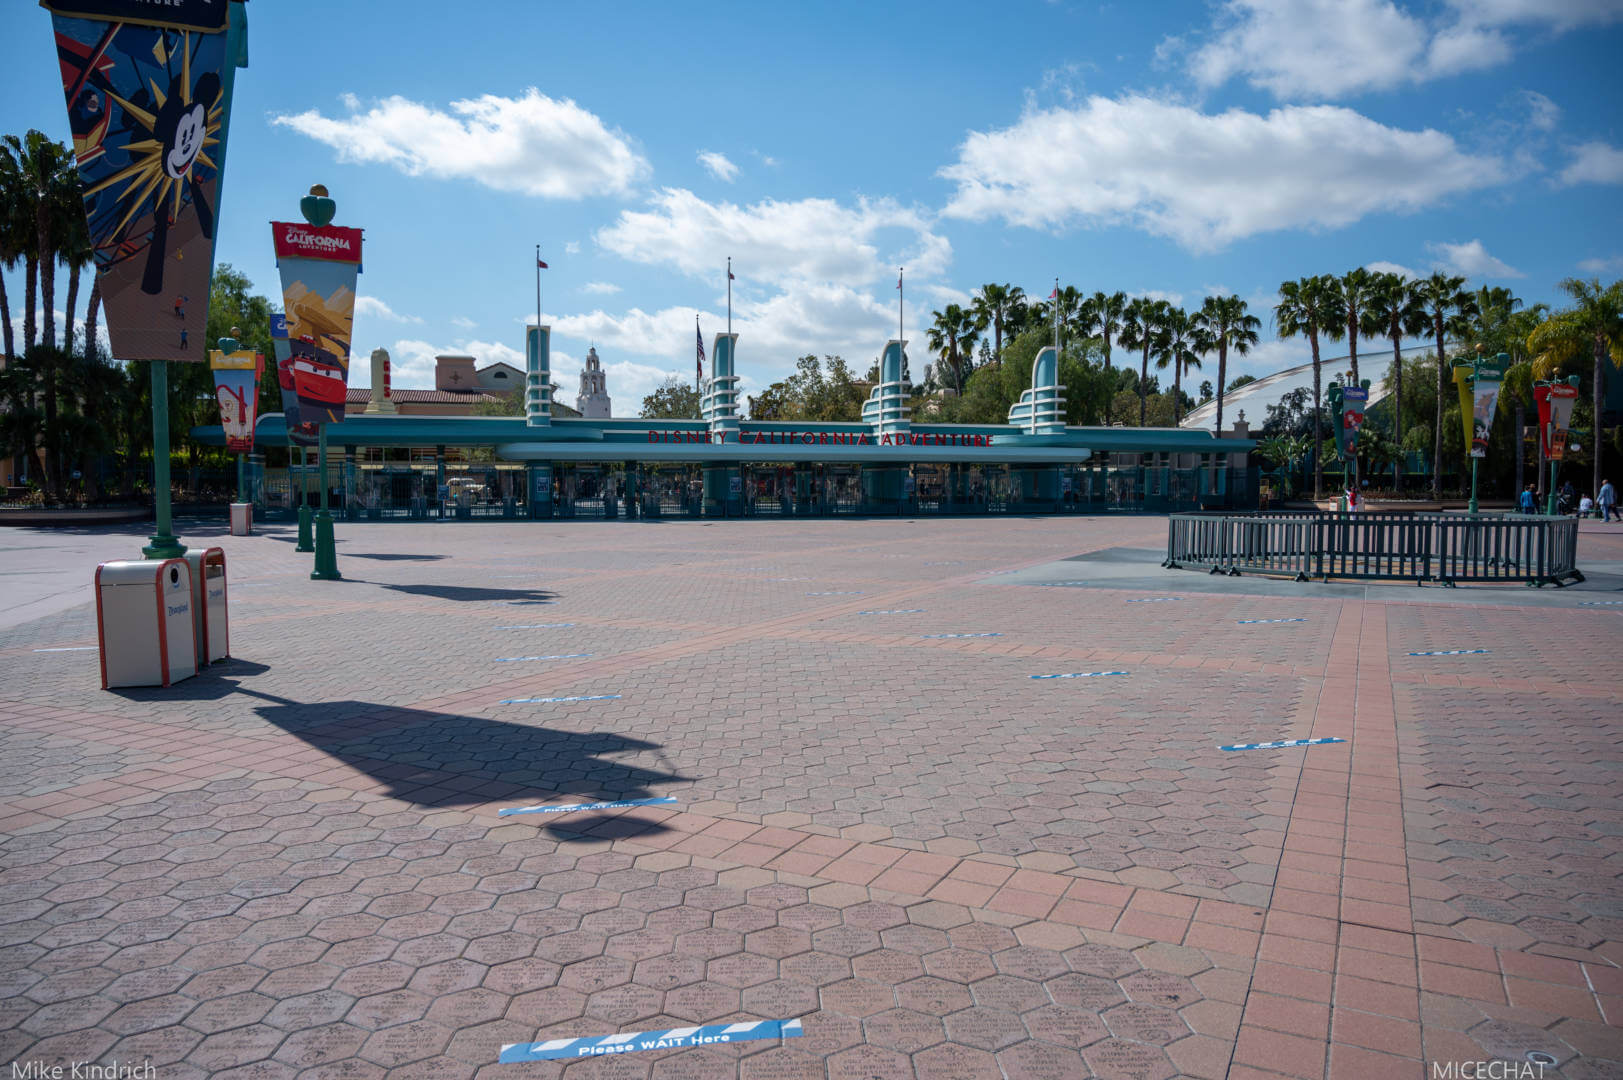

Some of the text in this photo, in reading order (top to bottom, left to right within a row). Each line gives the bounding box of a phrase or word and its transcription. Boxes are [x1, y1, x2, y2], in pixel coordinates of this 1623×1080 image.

[286, 233, 351, 250] CALIFORNIA
[648, 430, 994, 447] DISNEY CALIFORNIA ADVENTURE
[578, 1034, 730, 1056] Please WAIT Here
